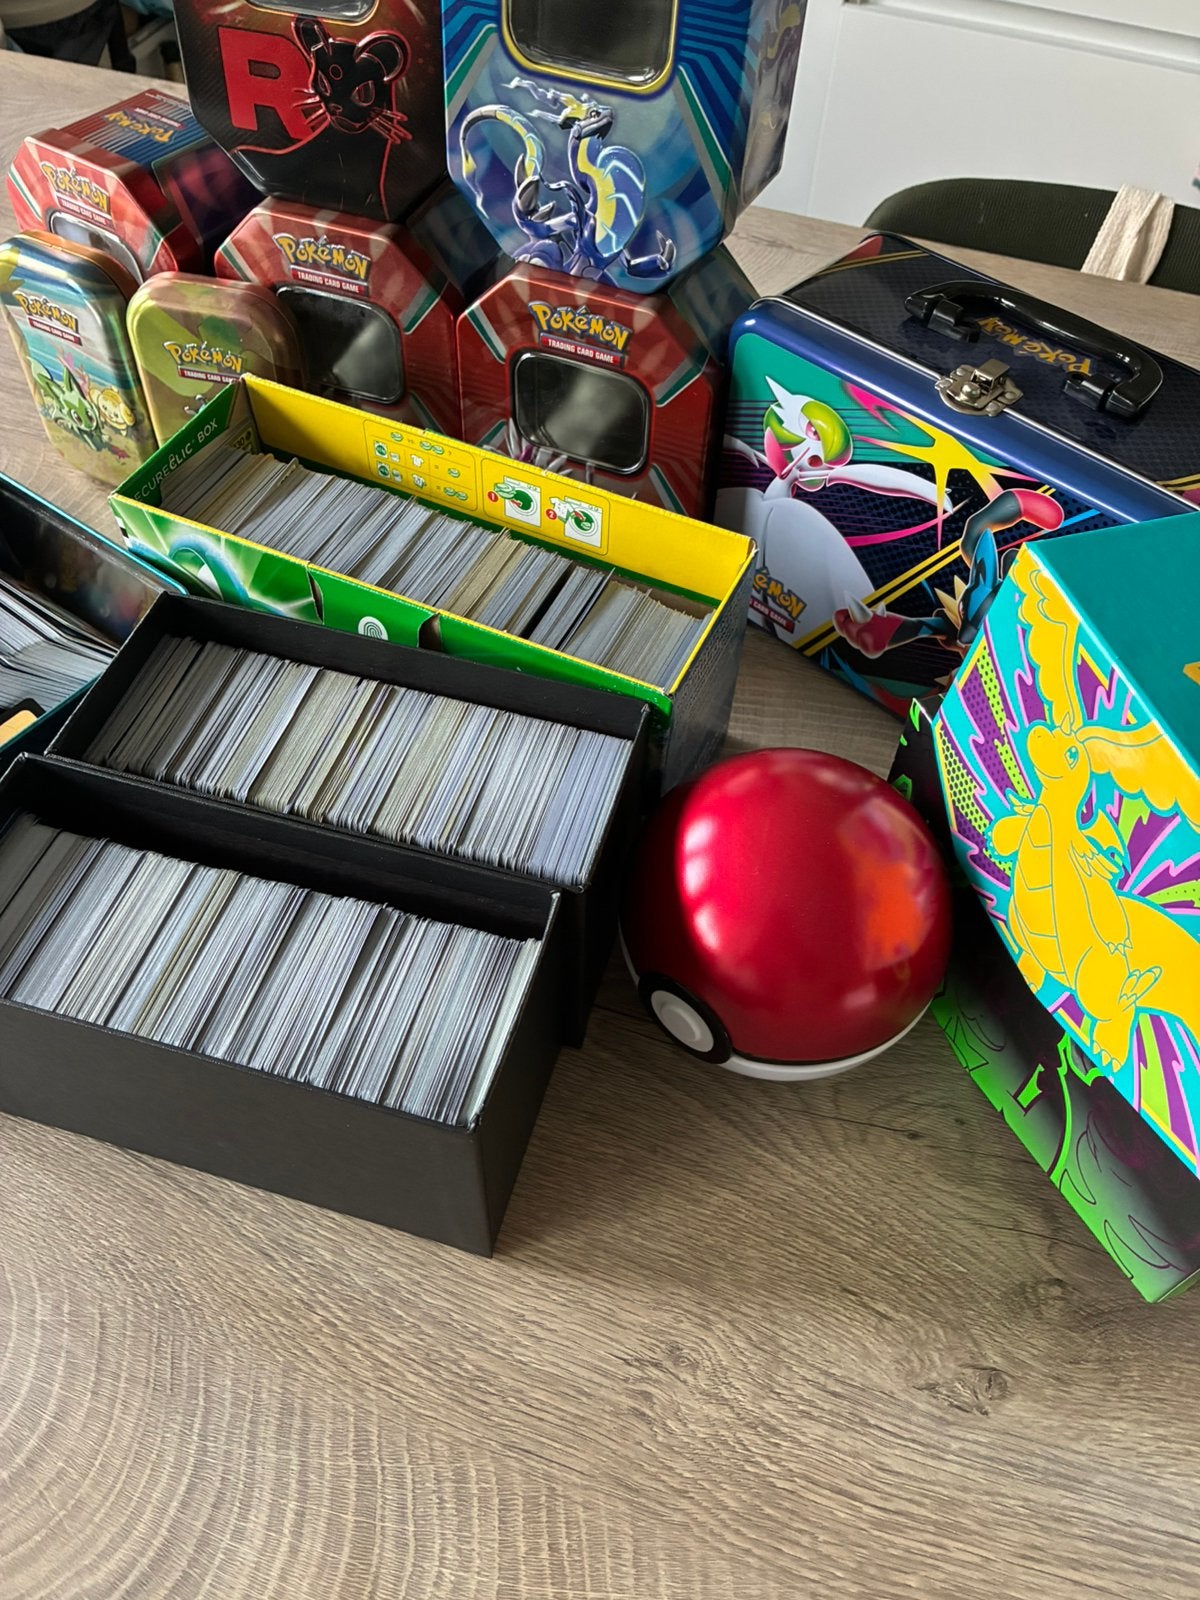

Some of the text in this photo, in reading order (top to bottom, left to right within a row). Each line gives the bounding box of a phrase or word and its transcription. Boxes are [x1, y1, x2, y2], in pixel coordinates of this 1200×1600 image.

[218, 26, 313, 141] R
[297, 271, 360, 294] TRADING CARD GAME
[548, 338, 614, 364] TRADING CARD GAME
[197, 418, 219, 443] BOX
